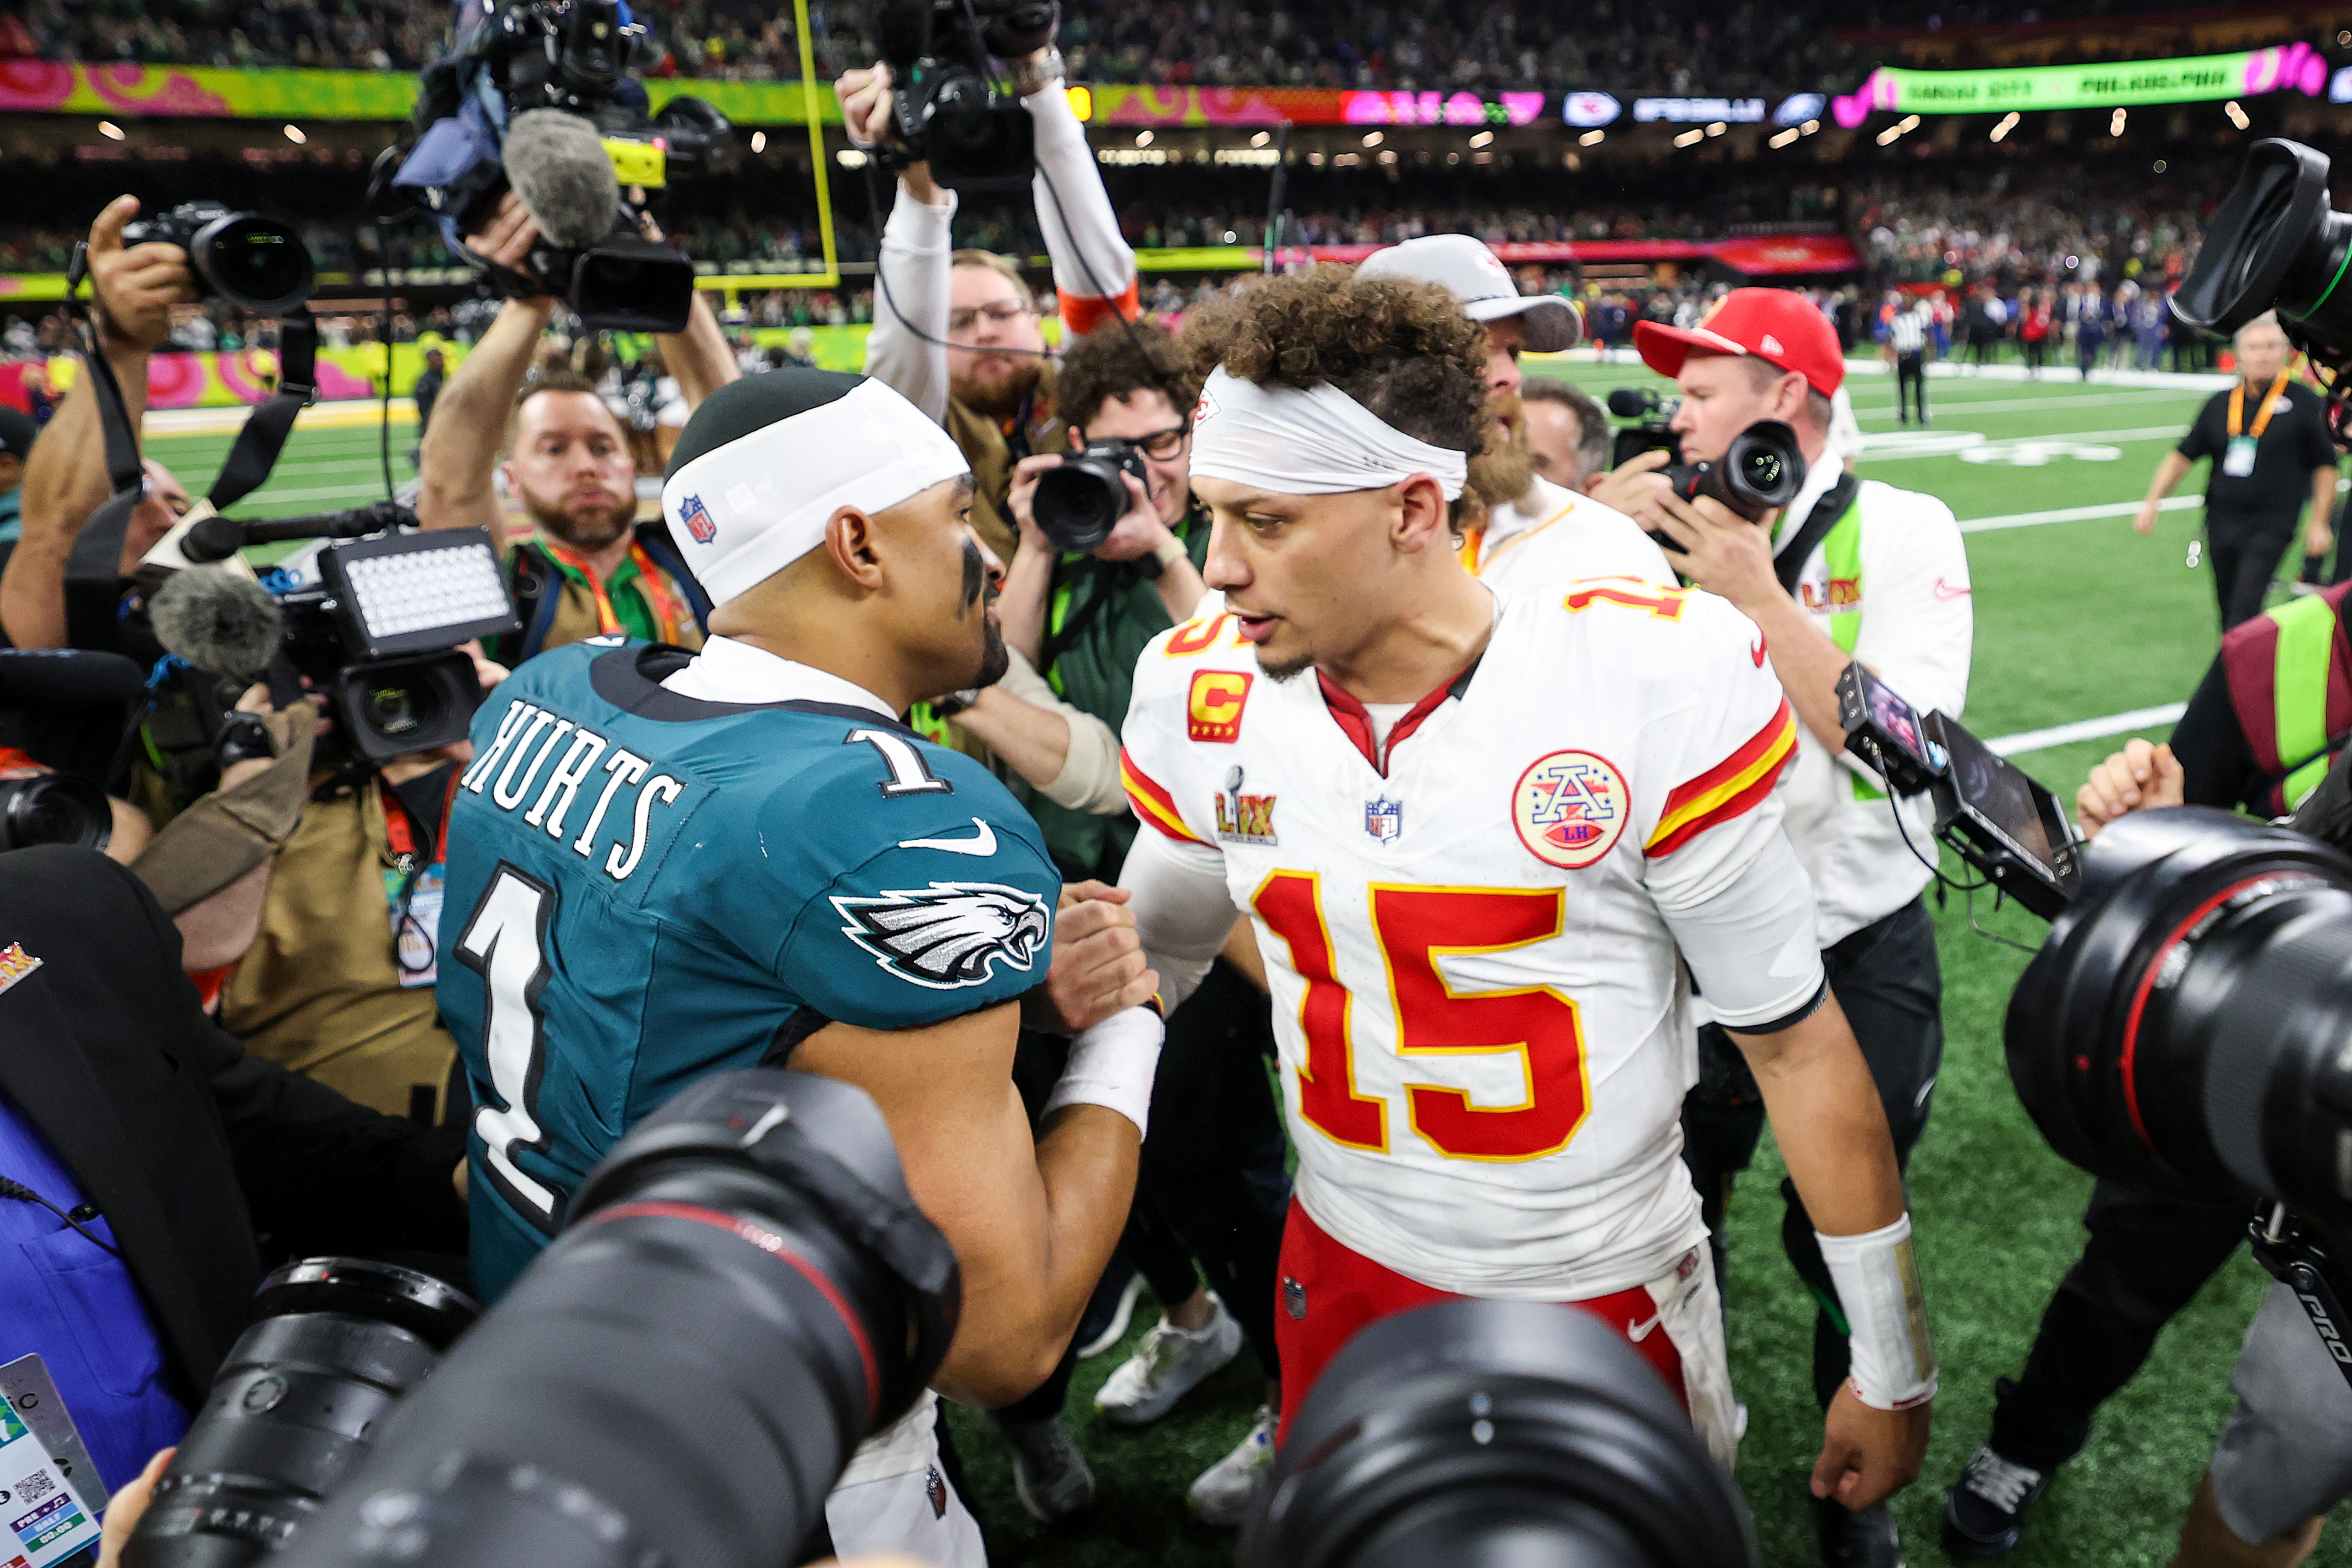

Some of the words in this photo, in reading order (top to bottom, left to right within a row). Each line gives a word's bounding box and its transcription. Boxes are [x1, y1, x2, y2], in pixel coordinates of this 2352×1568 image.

[1190, 672, 1247, 724] C
[461, 699, 686, 882] HURTS
[843, 728, 954, 798] 1
[1532, 764, 1614, 825] A
[1214, 792, 1277, 835] LIX
[1563, 825, 1589, 840] LH
[452, 858, 569, 1238] 1
[1249, 868, 1592, 1163] 15
